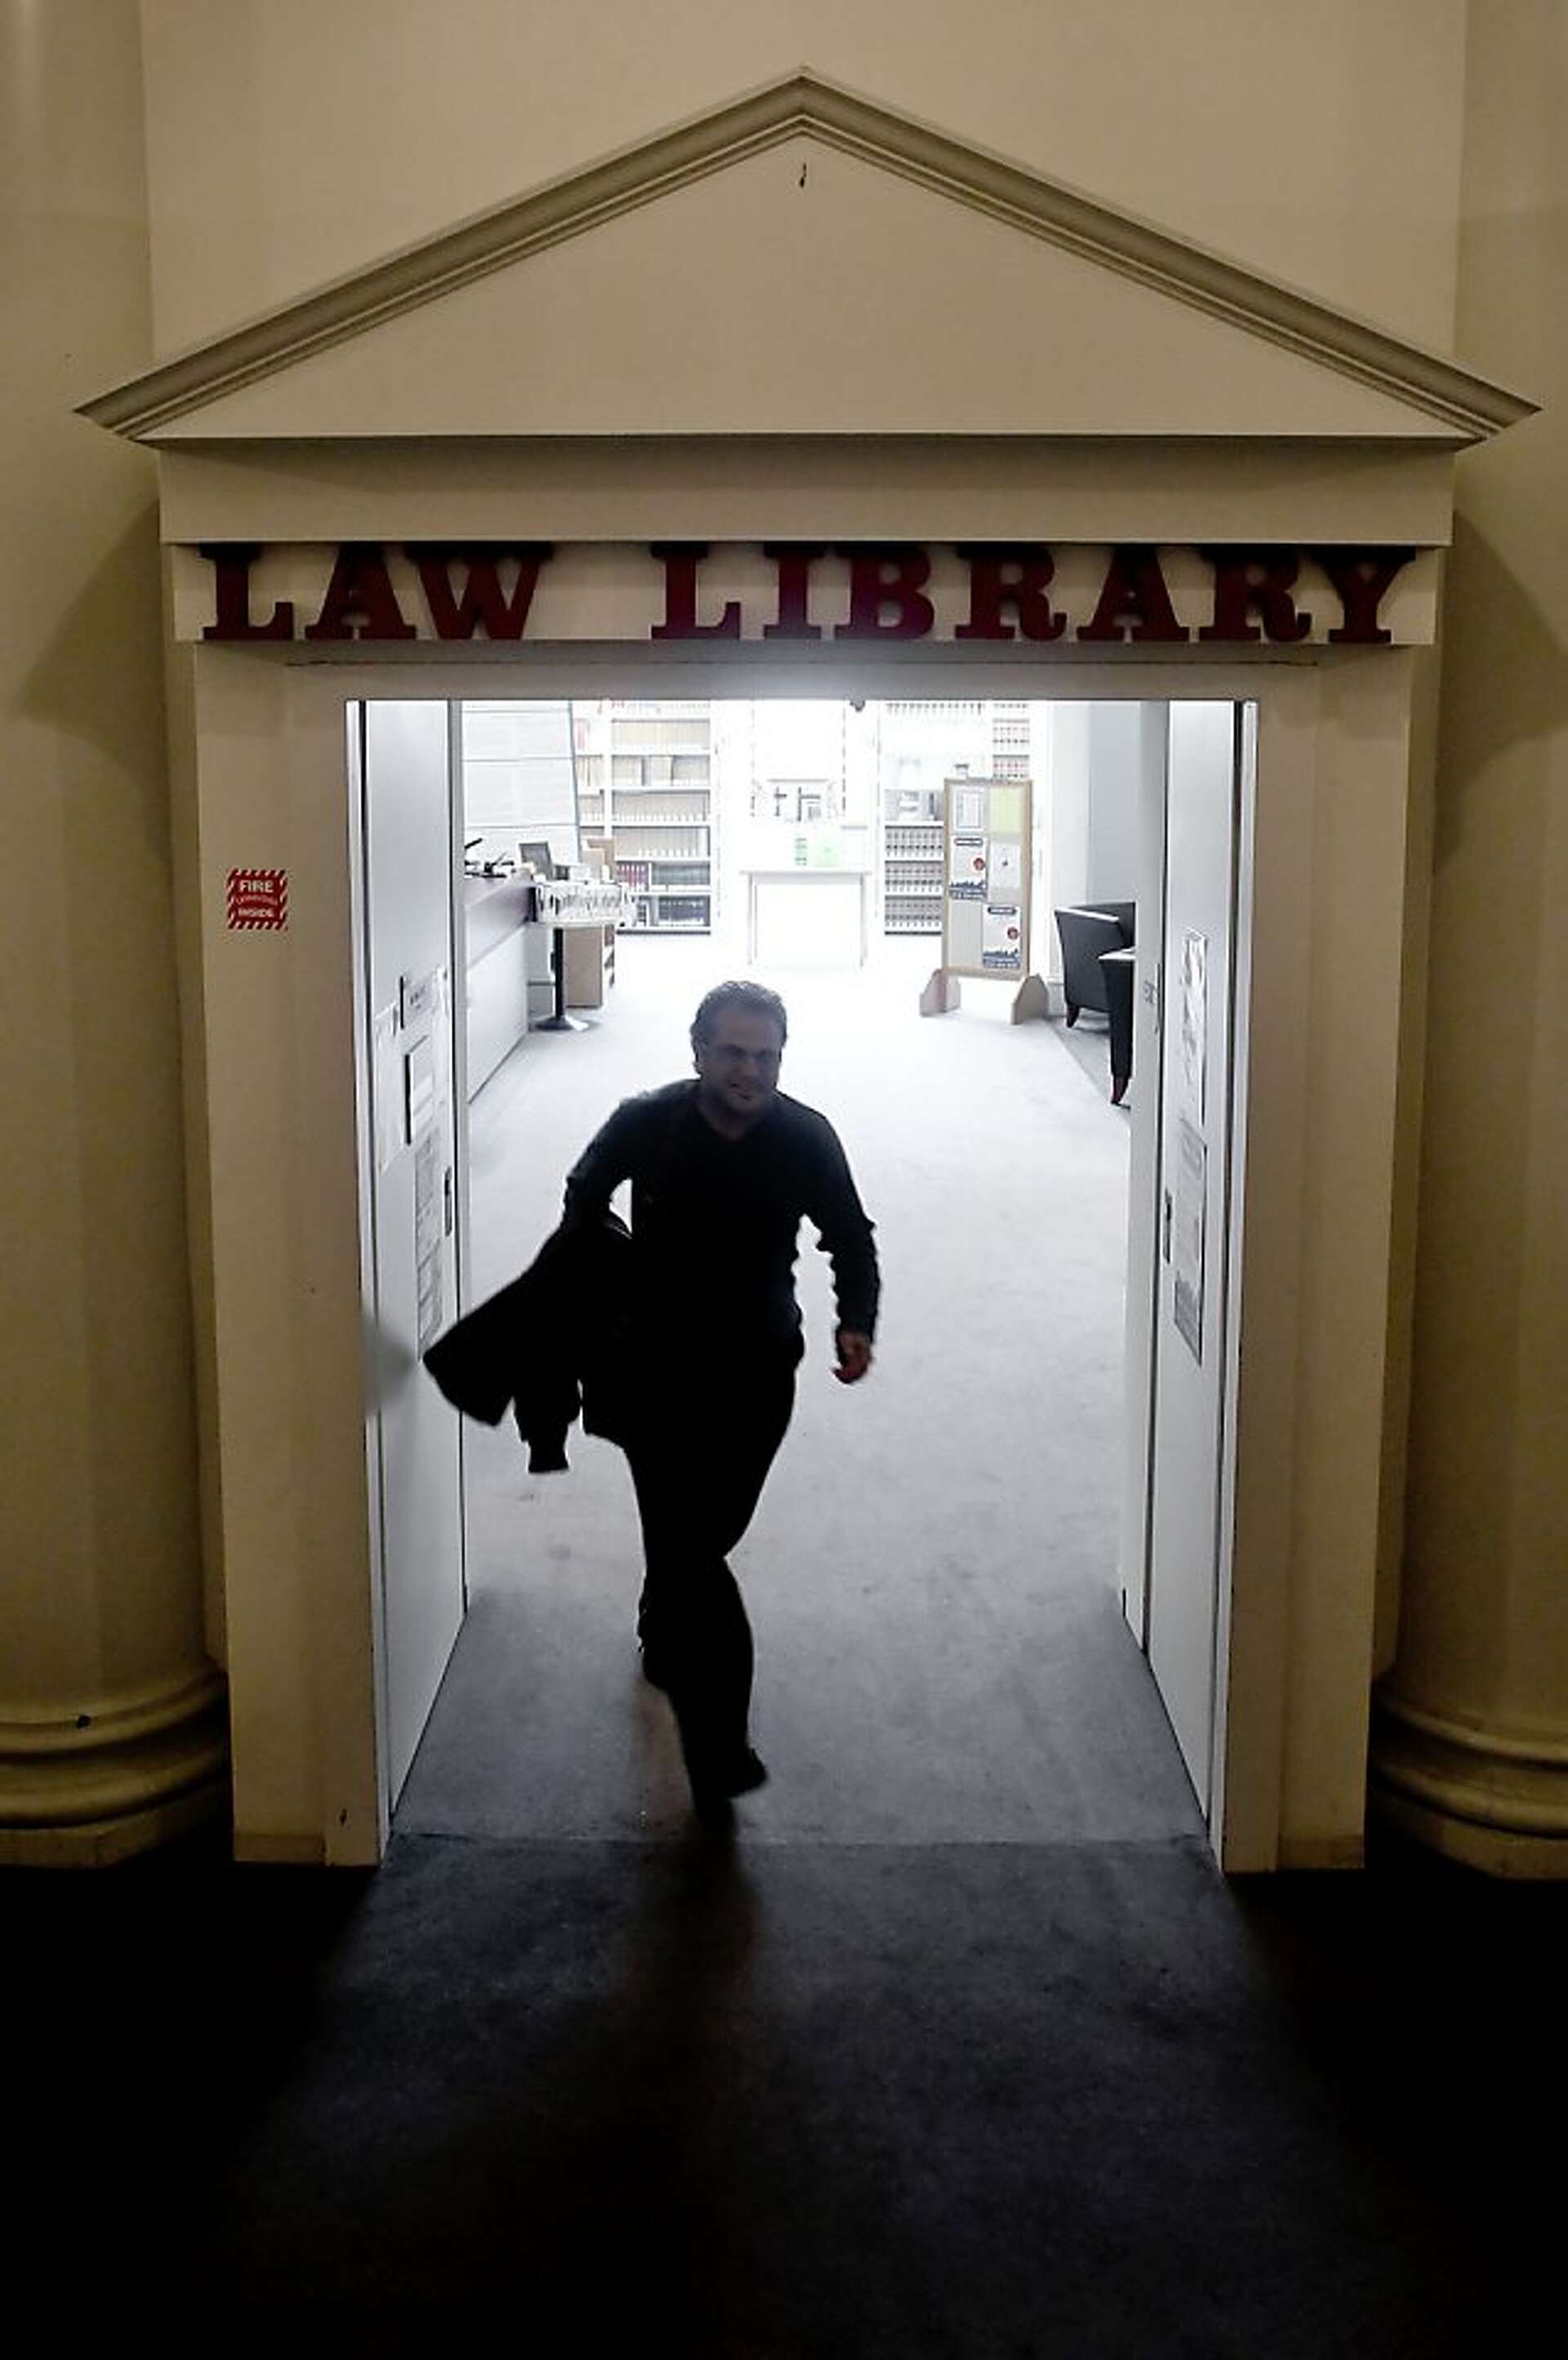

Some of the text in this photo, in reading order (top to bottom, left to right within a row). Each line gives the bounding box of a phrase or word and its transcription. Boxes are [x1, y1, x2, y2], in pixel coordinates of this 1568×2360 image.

[200, 542, 1417, 642] LAW LIBRARY
[239, 880, 274, 893] FIRE
